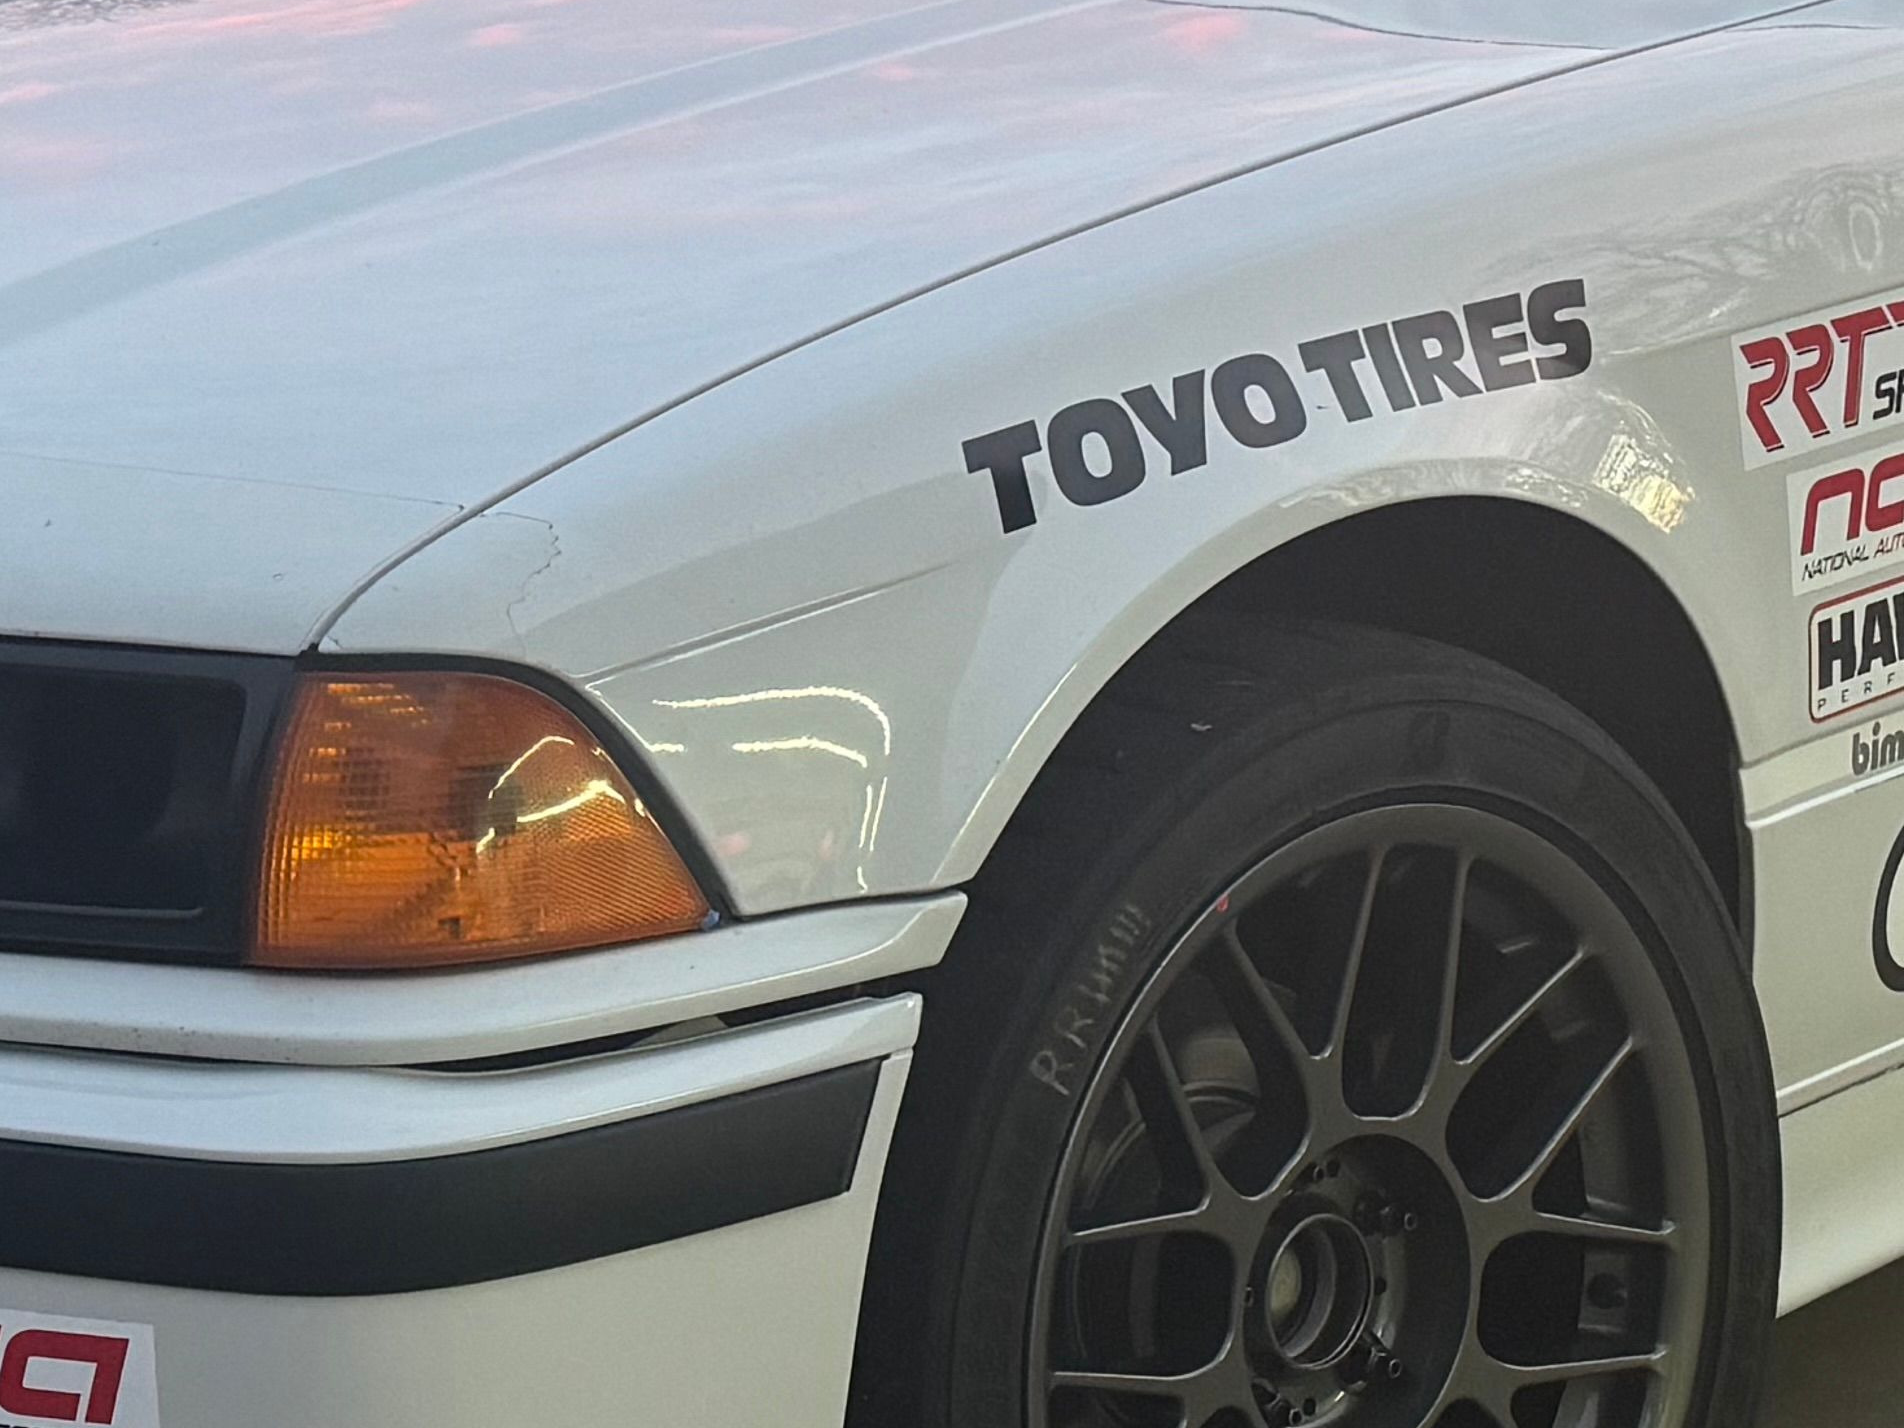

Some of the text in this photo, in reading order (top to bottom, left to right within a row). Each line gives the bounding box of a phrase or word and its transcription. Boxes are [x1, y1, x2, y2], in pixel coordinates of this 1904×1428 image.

[962, 278, 1593, 534] TOYO TIRES
[1739, 305, 1894, 452] RRT
[1802, 544, 1869, 581] NATIONAL
